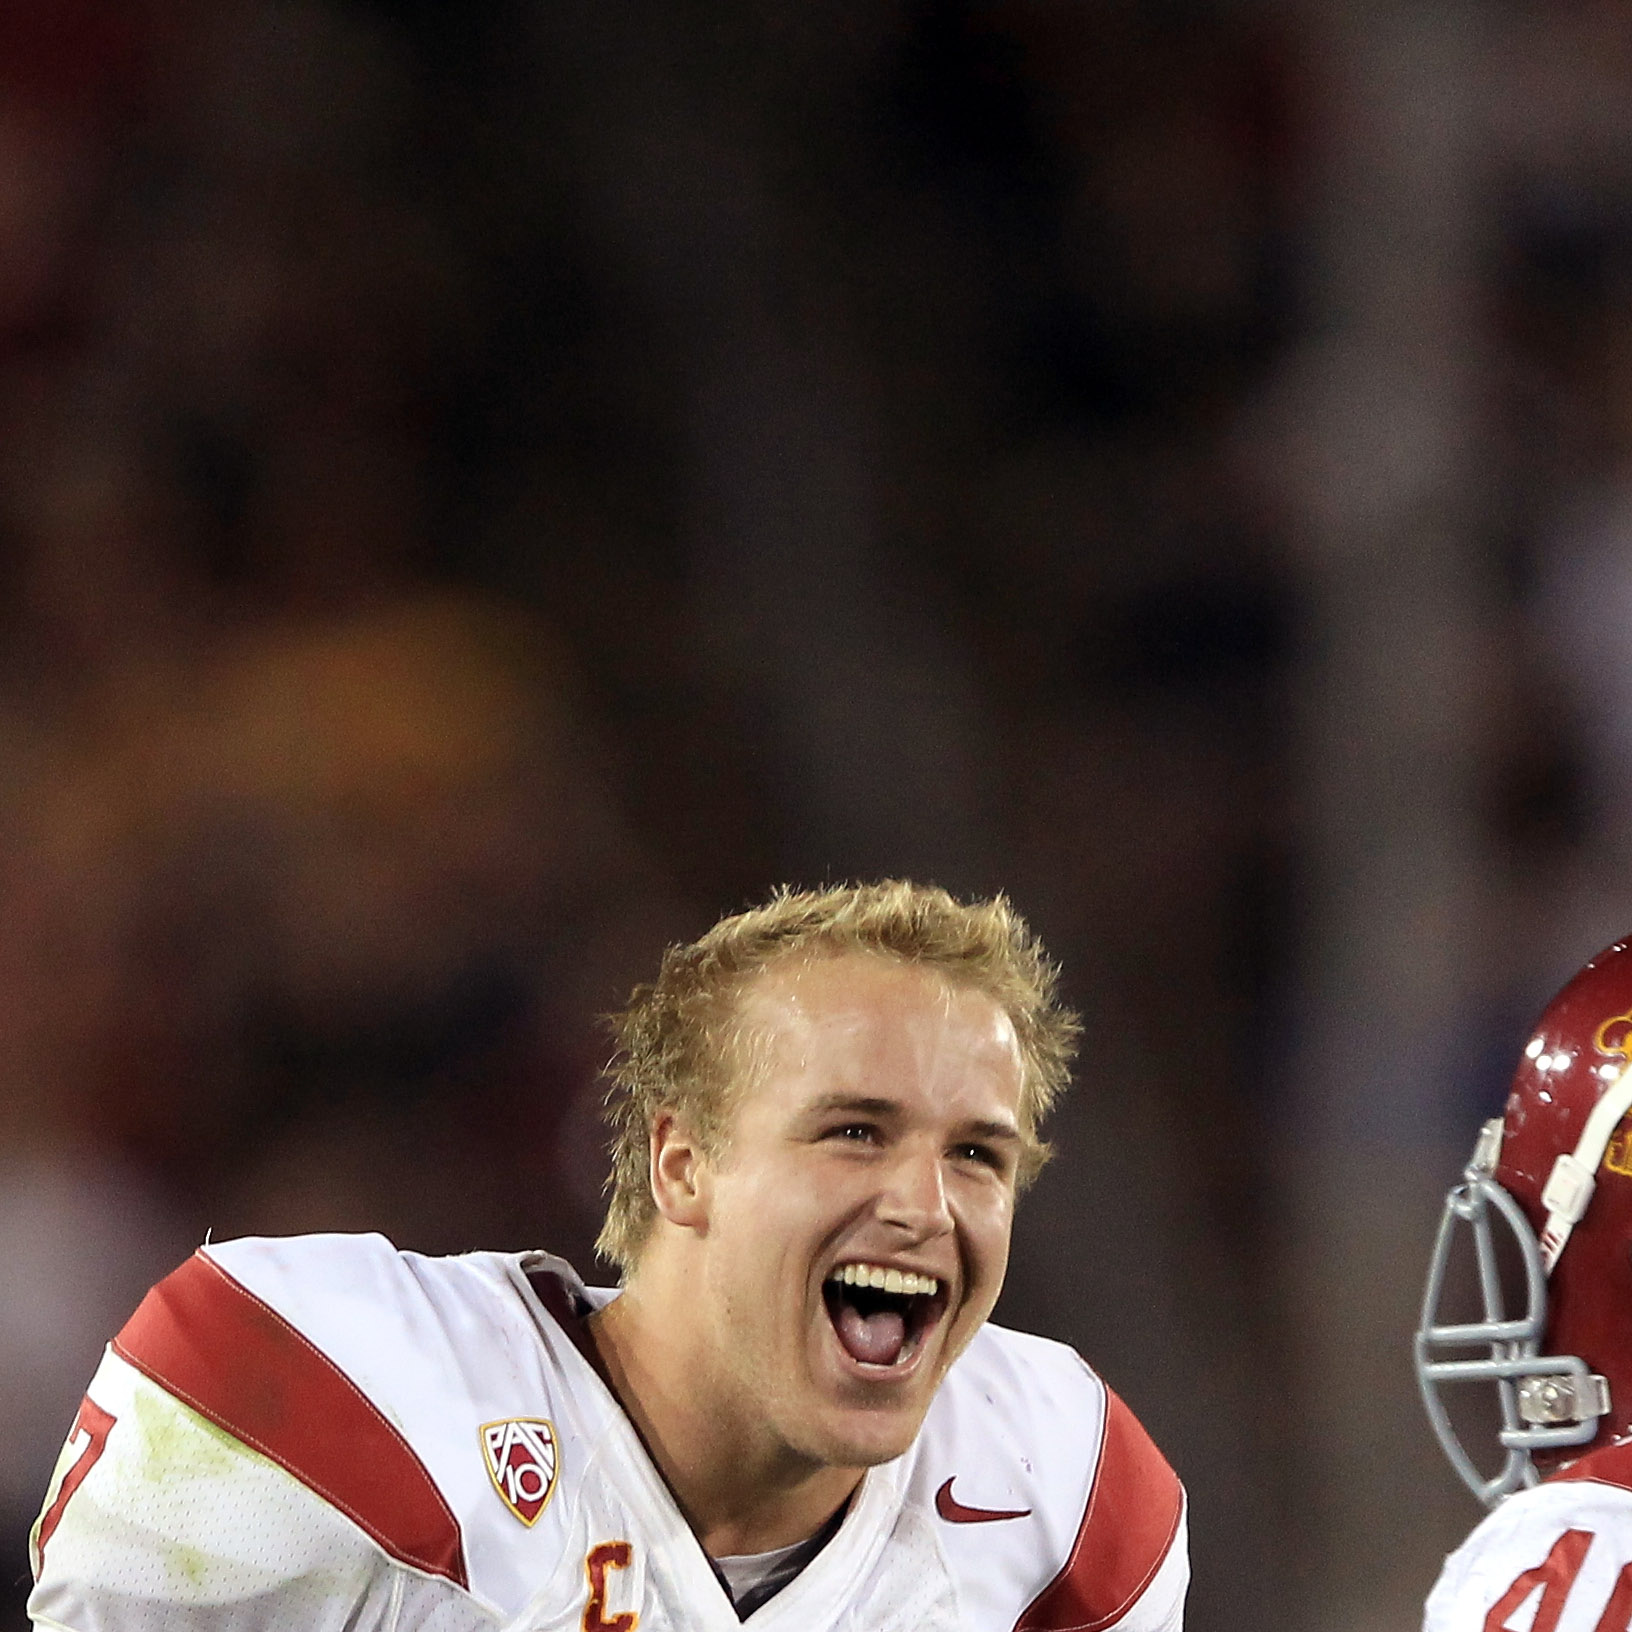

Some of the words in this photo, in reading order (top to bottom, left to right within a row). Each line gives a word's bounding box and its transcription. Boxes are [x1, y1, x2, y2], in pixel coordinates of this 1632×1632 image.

[483, 1420, 556, 1483] PAC
[35, 1393, 118, 1583] 7
[505, 1463, 549, 1505] 10
